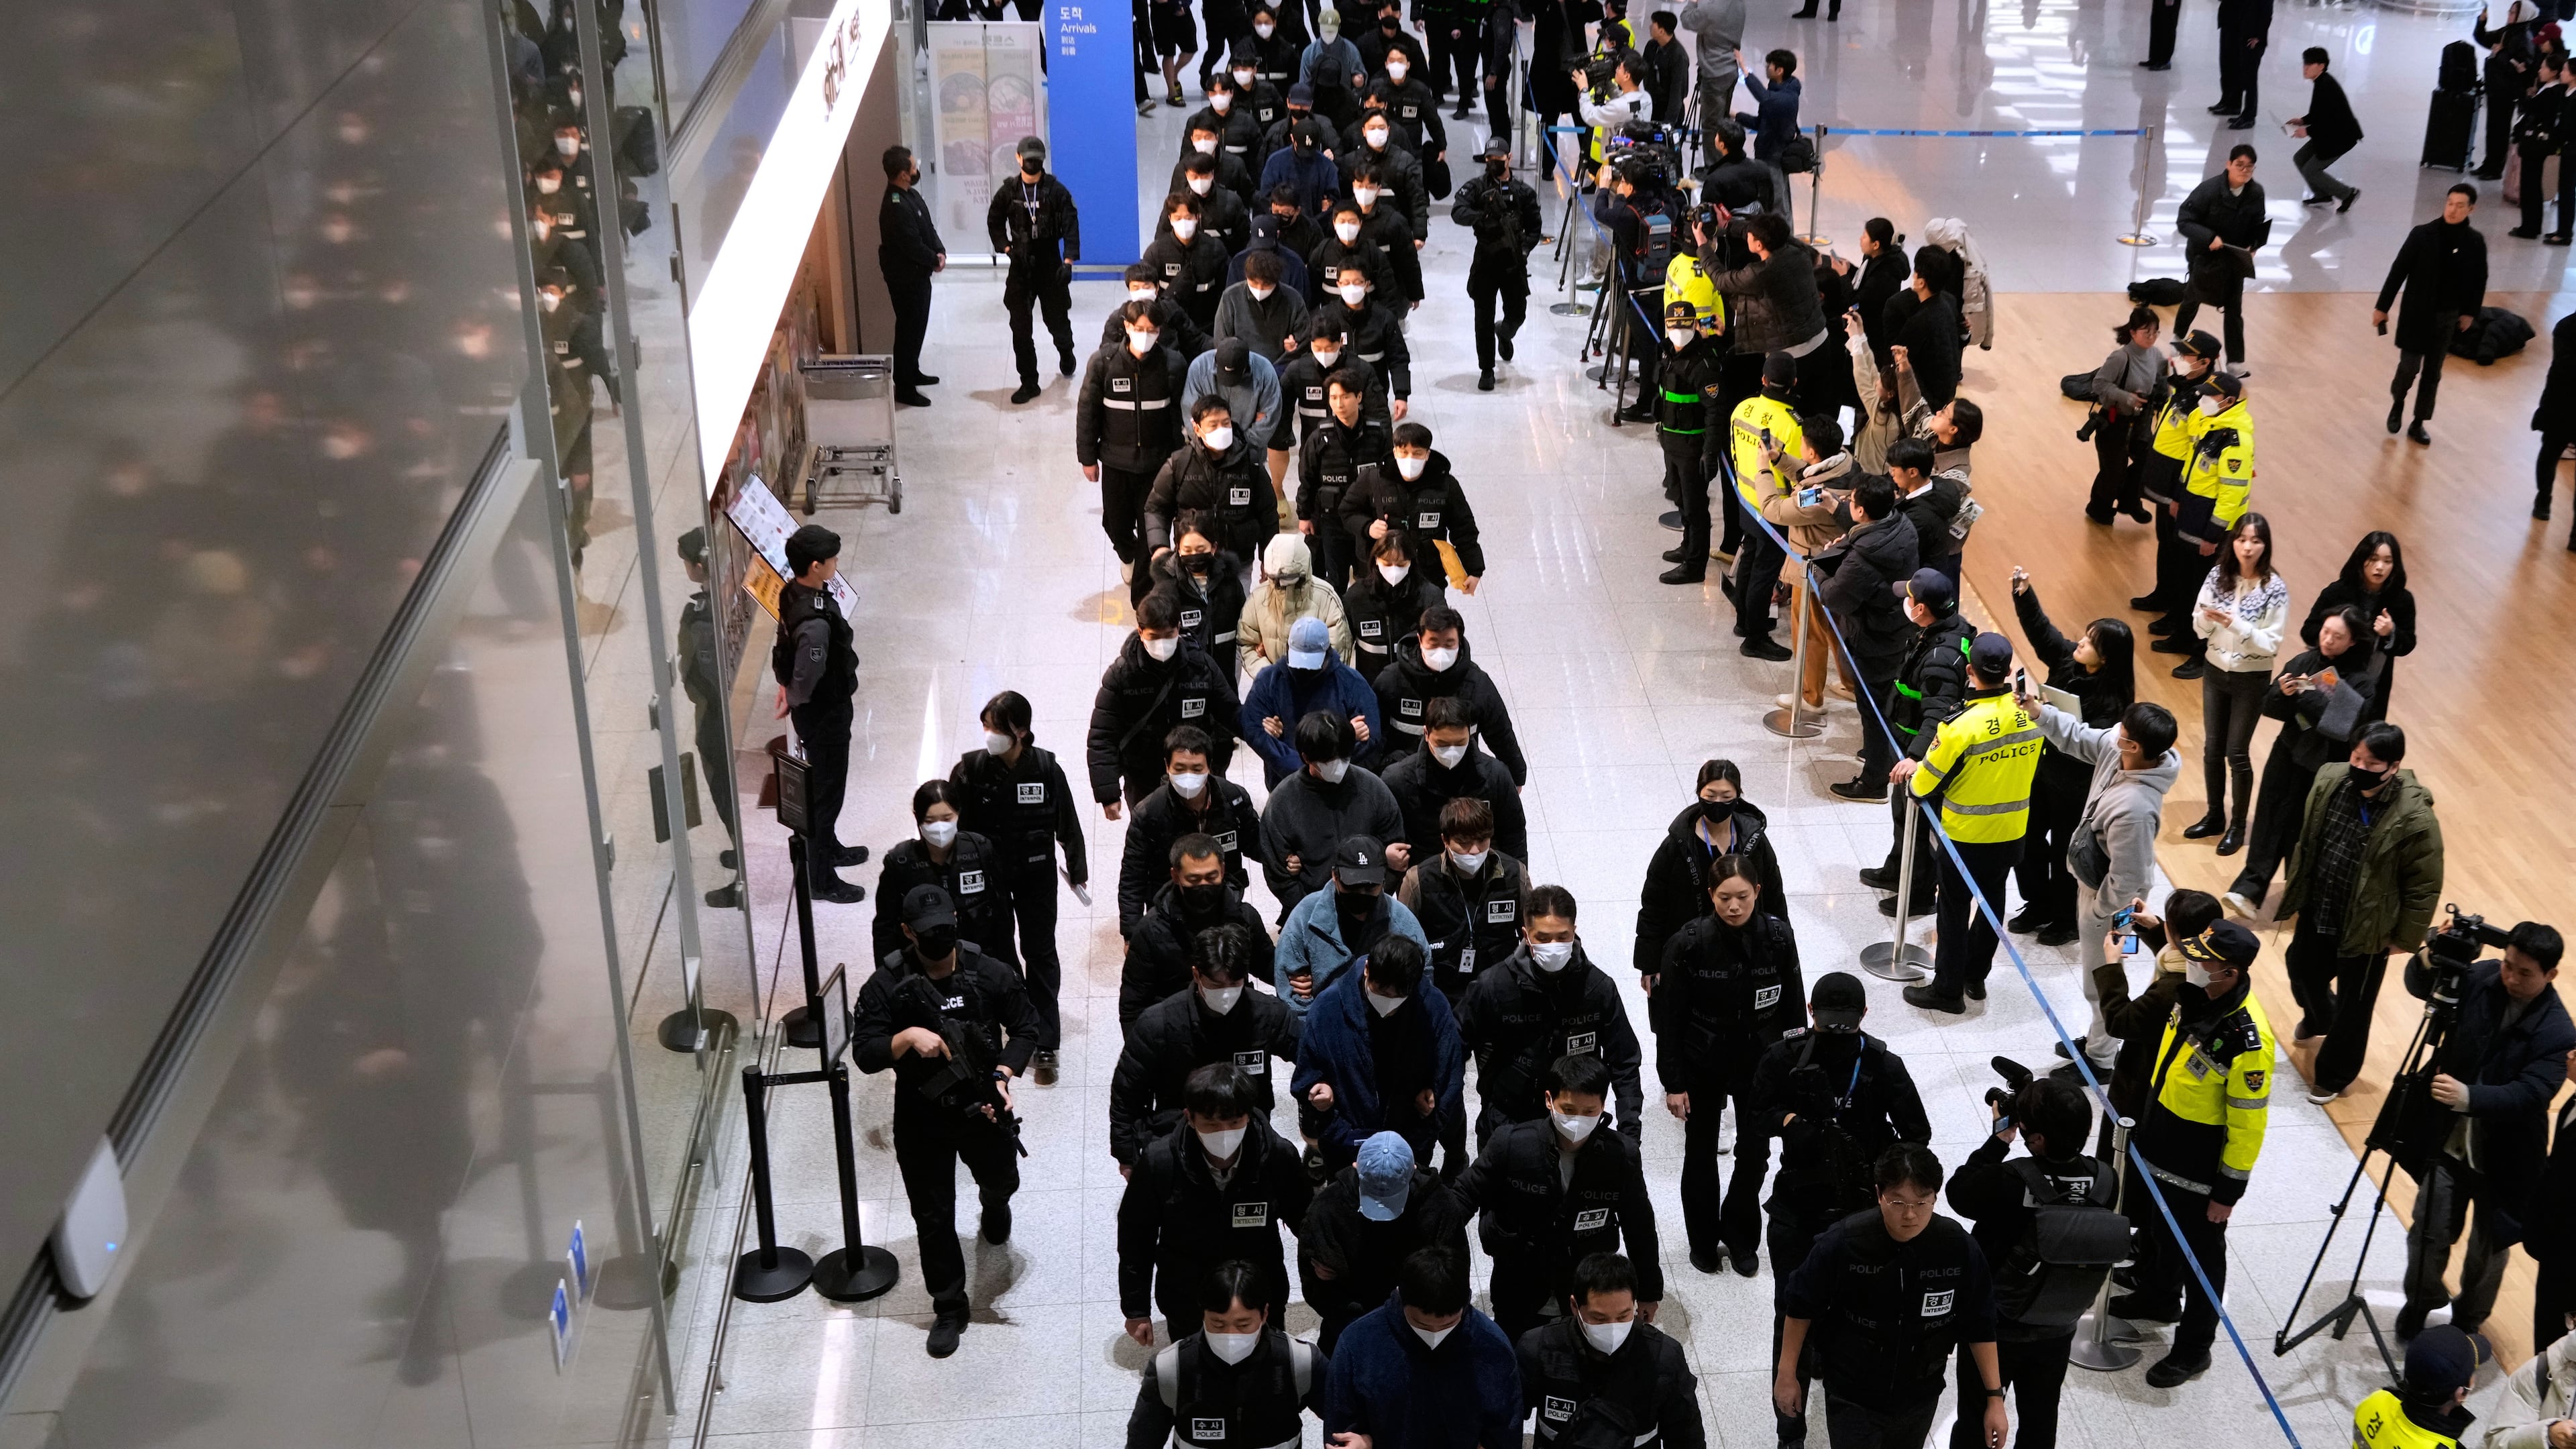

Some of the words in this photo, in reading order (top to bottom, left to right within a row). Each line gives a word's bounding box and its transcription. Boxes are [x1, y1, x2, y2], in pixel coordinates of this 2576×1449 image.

[1060, 7, 1082, 21] 도착
[1061, 22, 1097, 34] Arrivals
[1652, 242, 1667, 250] LiveU
[1736, 429, 1760, 446] POLI
[1322, 475, 1347, 483] POLICE
[1417, 497, 1446, 506] POLICE
[1122, 687, 1155, 696] POLICE
[1179, 682, 1209, 690] POLICE
[1986, 710, 2027, 735] 경찰
[1978, 744, 2037, 766] POLICE
[1358, 852, 1368, 865] LA
[1491, 903, 1512, 914] 형사
[1502, 1014, 1542, 1023] POLICE
[1562, 1012, 1600, 1026] POLICE
[1571, 1036, 1593, 1049] 형사
[1238, 1053, 1260, 1065] 형사
[1237, 1205, 1263, 1216] 형사
[1920, 1267, 1962, 1279] POLICE
[1928, 1295, 1951, 1306] 경찰
[1924, 1305, 1950, 1314] INTERPOL
[1846, 1310, 1877, 1329] OLICE
[1550, 1401, 1571, 1411] 수사
[1197, 1421, 1220, 1430] 수사
